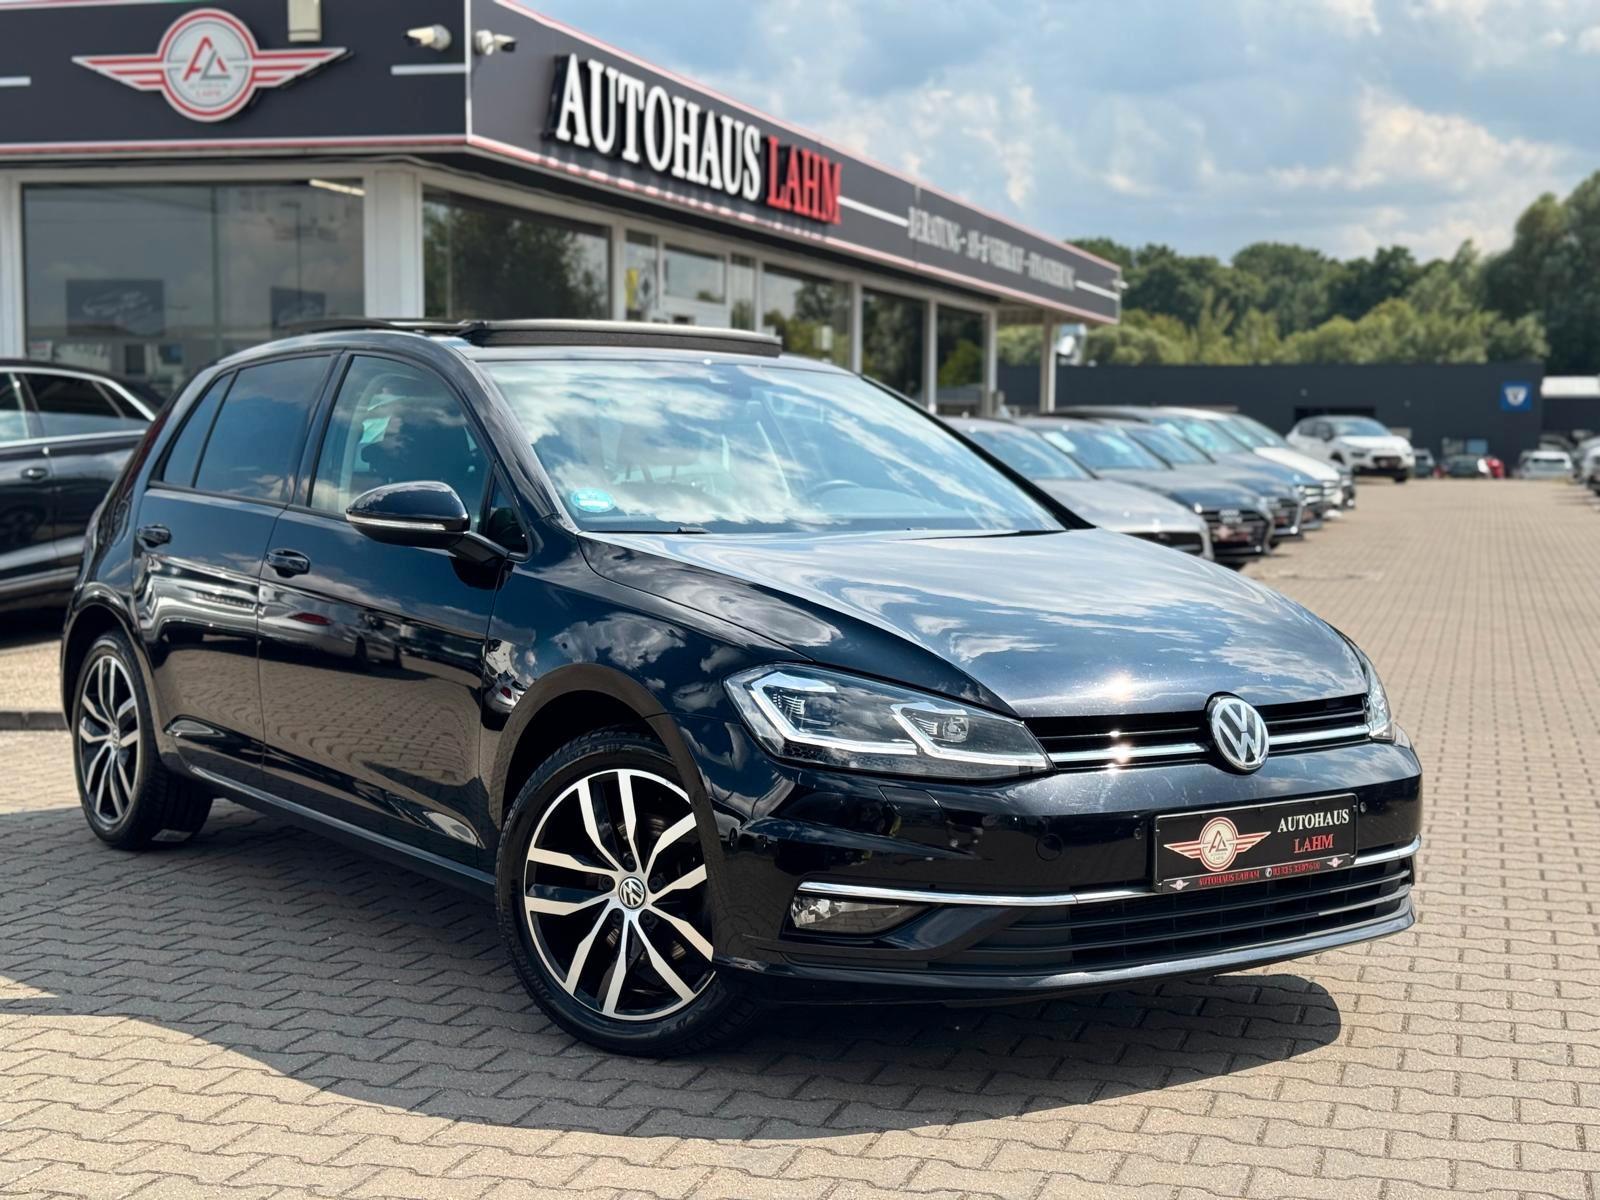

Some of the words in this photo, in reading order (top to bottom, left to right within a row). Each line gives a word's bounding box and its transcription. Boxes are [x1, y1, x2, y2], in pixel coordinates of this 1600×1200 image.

[556, 53, 761, 201] AUTOHAUS
[767, 135, 843, 224] LAHM
[1278, 809, 1349, 832] AUTOHAUS
[1294, 834, 1334, 853] LAHM
